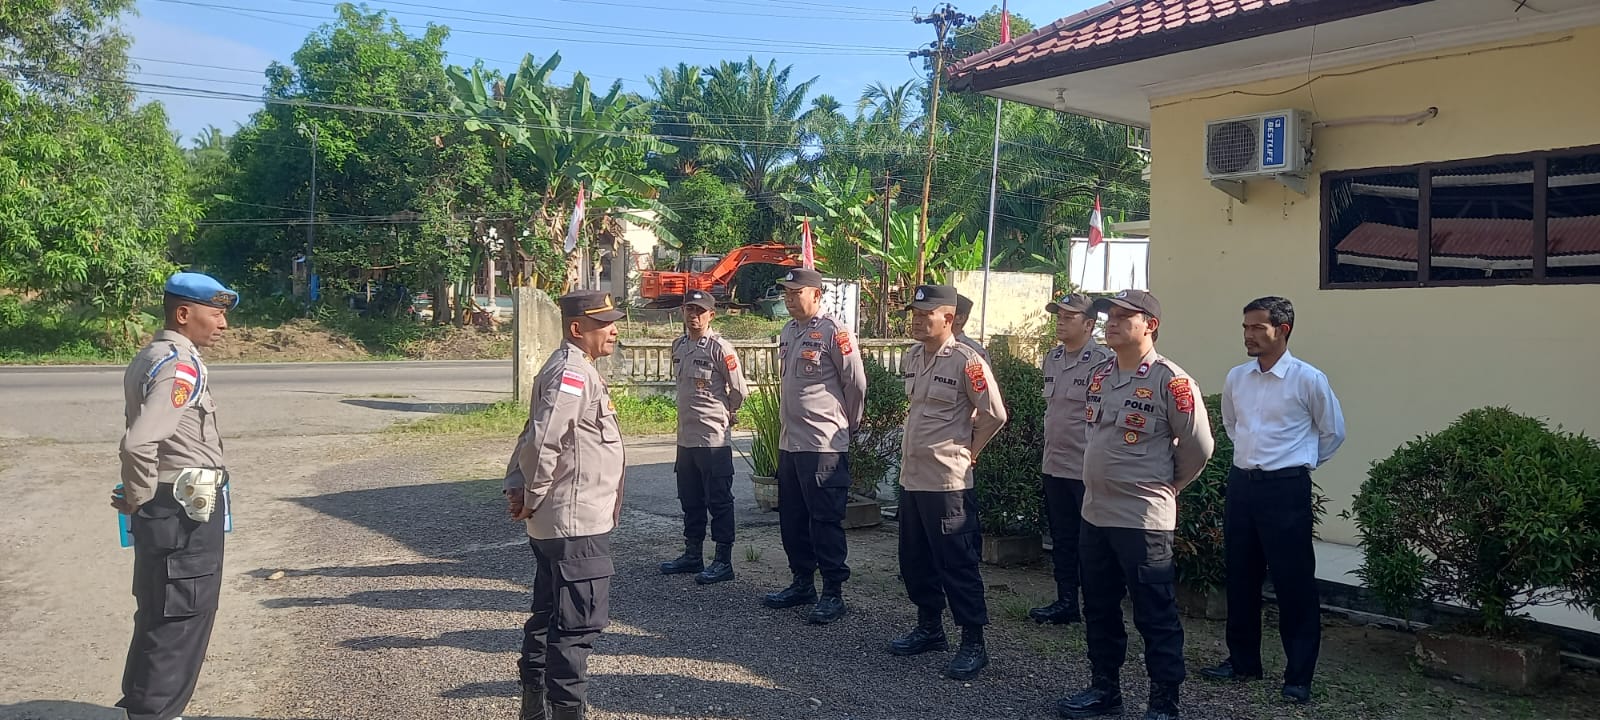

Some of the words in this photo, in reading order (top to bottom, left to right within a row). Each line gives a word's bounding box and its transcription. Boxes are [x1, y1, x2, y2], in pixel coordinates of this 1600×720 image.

[1266, 121, 1274, 163] BESTLIFE
[933, 375, 957, 386] POLRI
[1073, 378, 1087, 386] POL
[1124, 399, 1155, 413] POLRI
